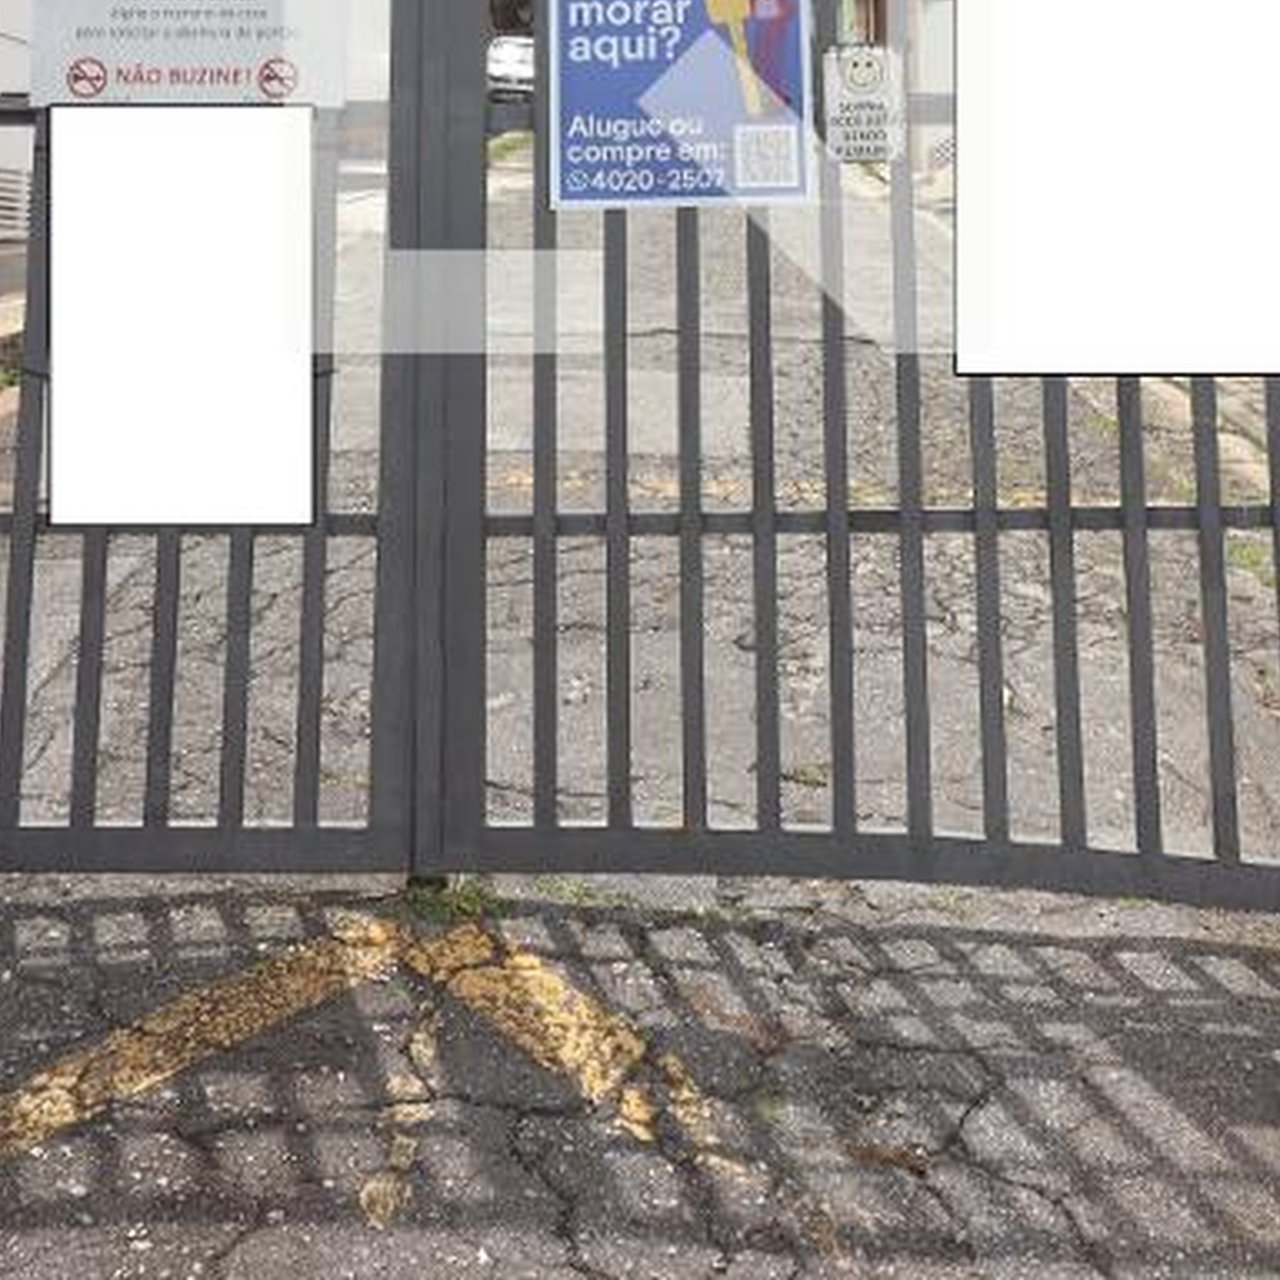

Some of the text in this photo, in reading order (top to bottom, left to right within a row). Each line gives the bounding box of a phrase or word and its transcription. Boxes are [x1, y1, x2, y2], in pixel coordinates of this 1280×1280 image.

[568, 25, 682, 68] aqui?
[116, 63, 252, 86] NÃO BUZINE!
[567, 113, 703, 141] Alugue ou
[567, 142, 671, 168] compre
